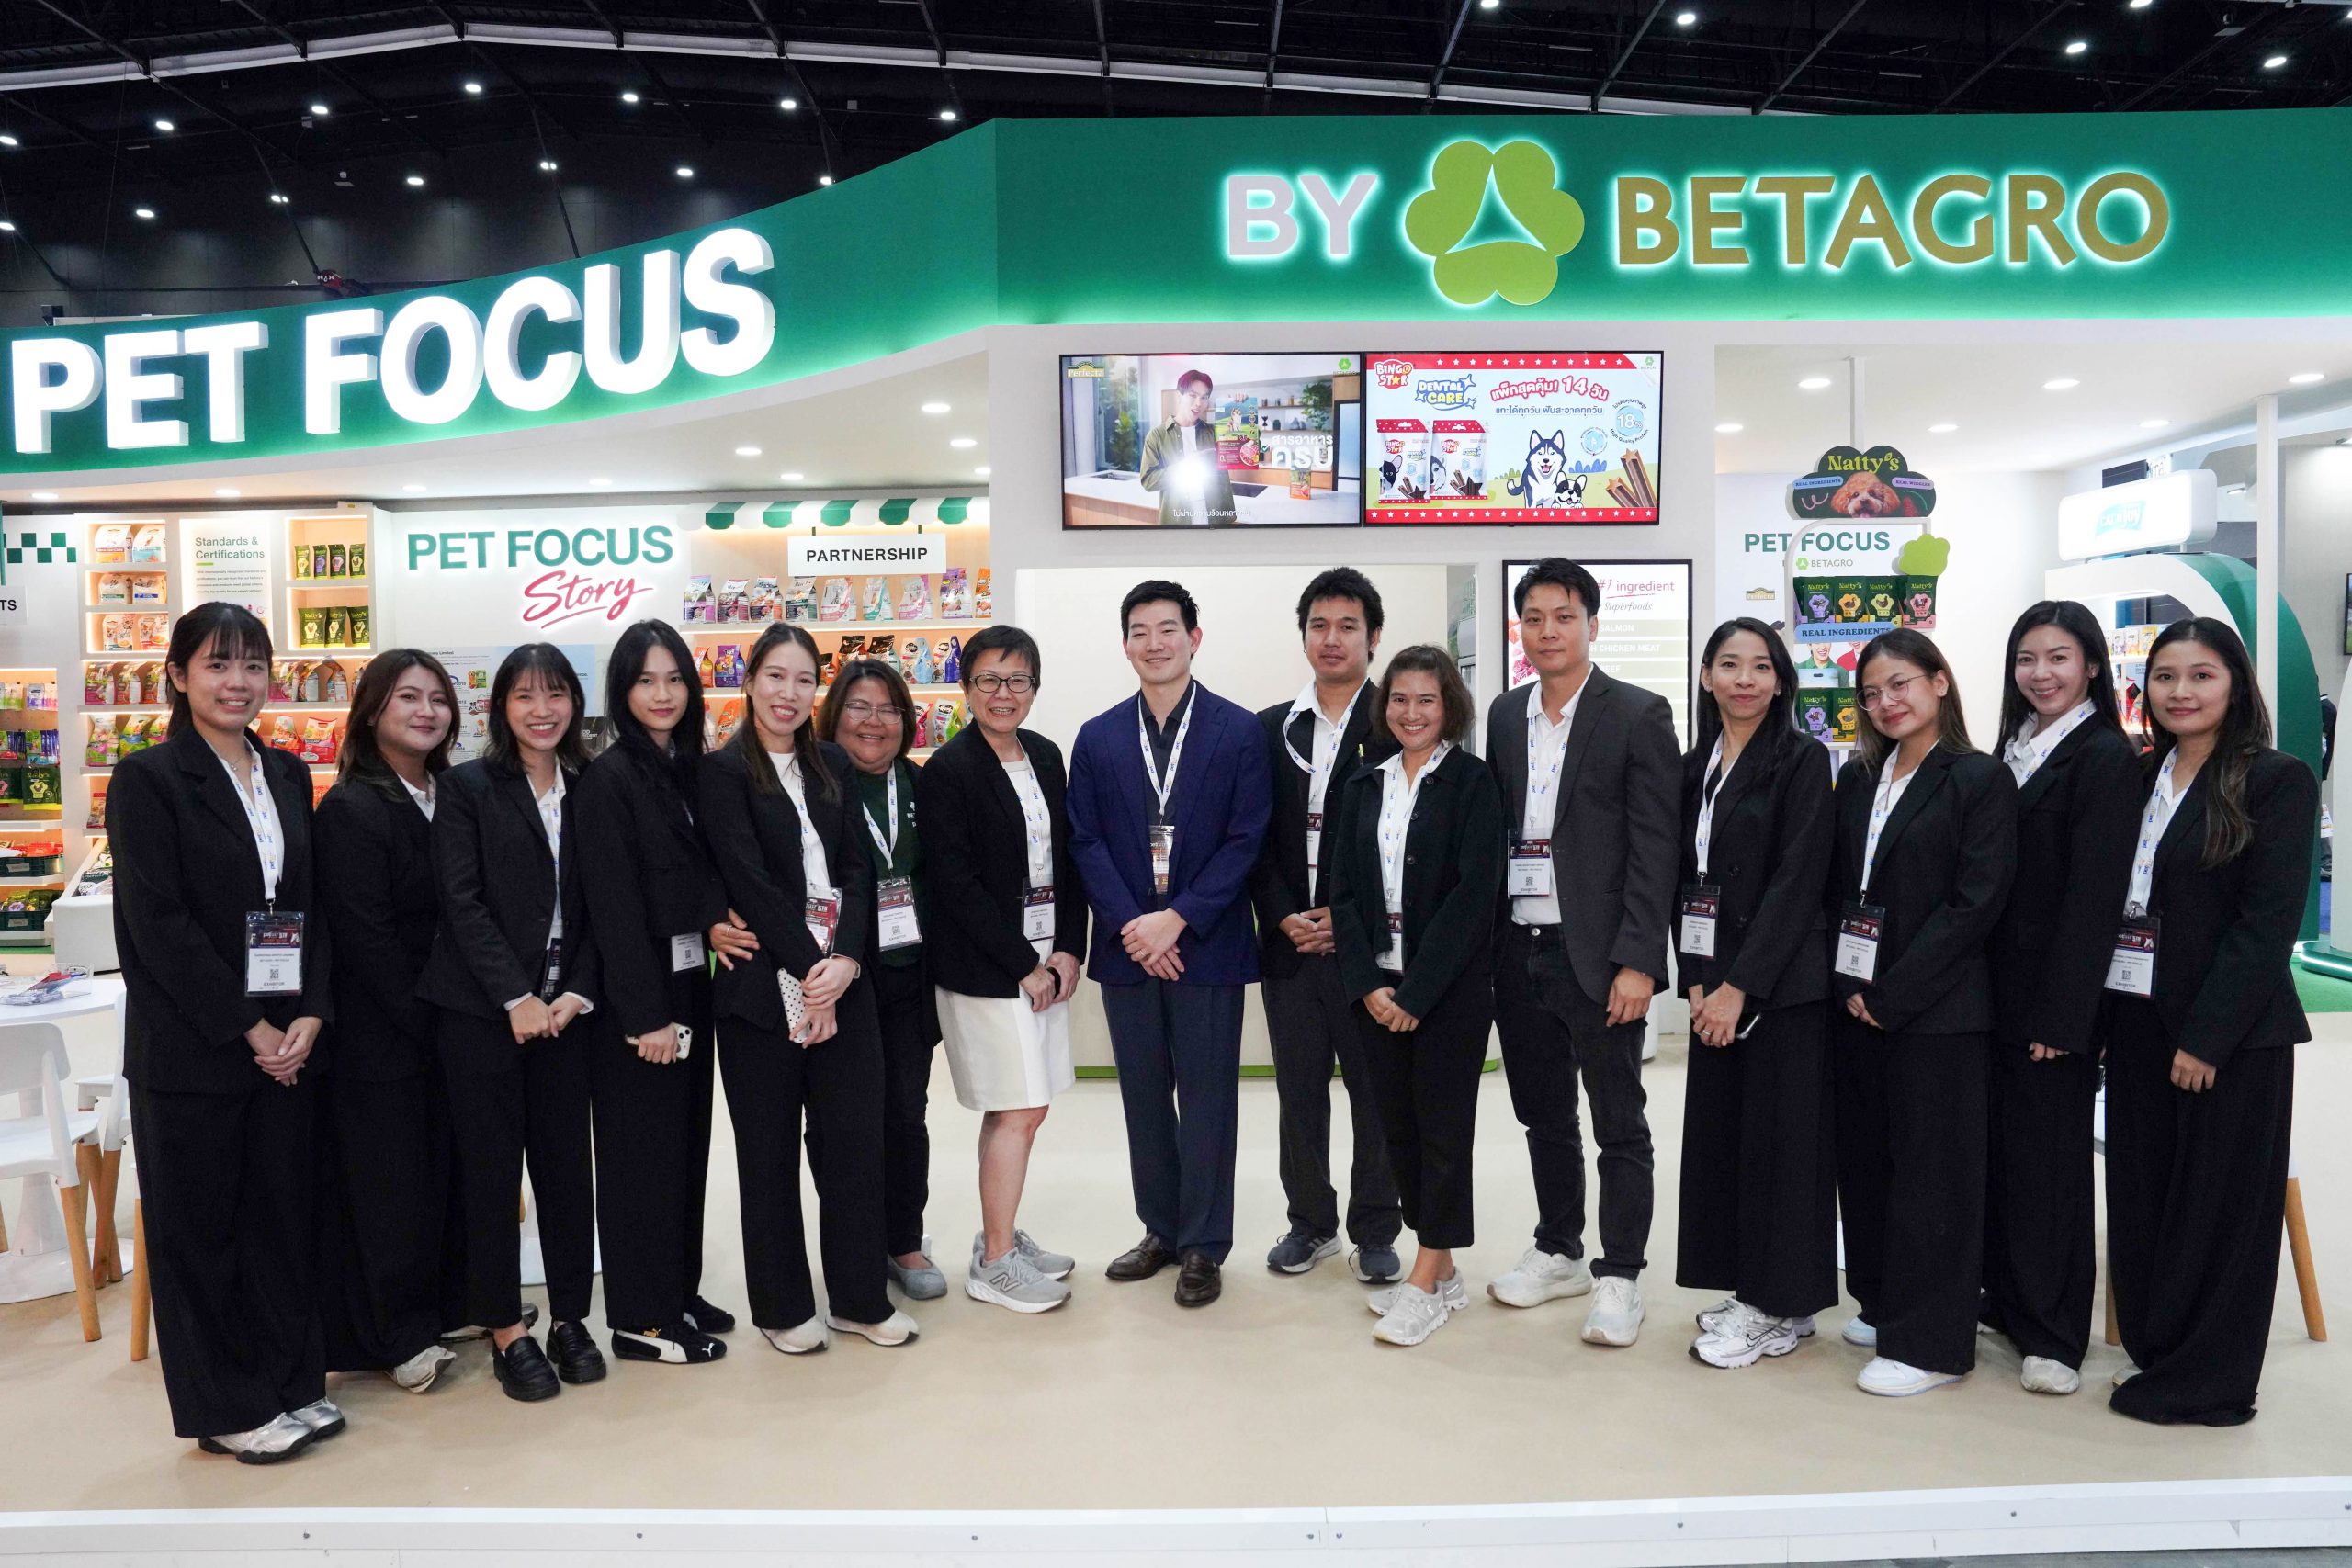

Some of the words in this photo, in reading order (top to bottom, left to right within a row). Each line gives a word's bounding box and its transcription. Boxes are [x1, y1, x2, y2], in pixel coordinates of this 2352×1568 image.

[1228, 173, 1379, 257] BY
[1616, 171, 2170, 270] BETAGRO
[11, 321, 268, 454] PET
[306, 227, 775, 435] FOCUS
[1069, 368, 1103, 377] Perfecta
[1376, 363, 1412, 375] BINGO
[1418, 380, 1464, 392] DENTAL
[1562, 375, 1588, 396] 14
[1427, 391, 1464, 404] CARE
[1272, 434, 1334, 446] สารอาหาร
[1827, 452, 1900, 474] Natty's
[196, 537, 249, 547] Standards
[251, 536, 258, 546] &
[408, 531, 495, 570] PET
[507, 525, 673, 568] FOCUS
[1745, 533, 1792, 553] PET
[1801, 531, 1891, 552] FOCUS
[196, 549, 266, 559] Certifications
[807, 547, 928, 562] PARTNERSHIP
[1811, 558, 1854, 568] BETAGRO
[1598, 578, 1612, 589] #1
[1616, 581, 1675, 594] ingredient
[523, 570, 654, 622] Story
[1604, 601, 1653, 614] Superfoods
[1600, 624, 1634, 632] SALMON
[1802, 629, 1826, 637] REAL
[1599, 644, 1634, 652] CHICKEN
[1638, 644, 1661, 652] MEAT
